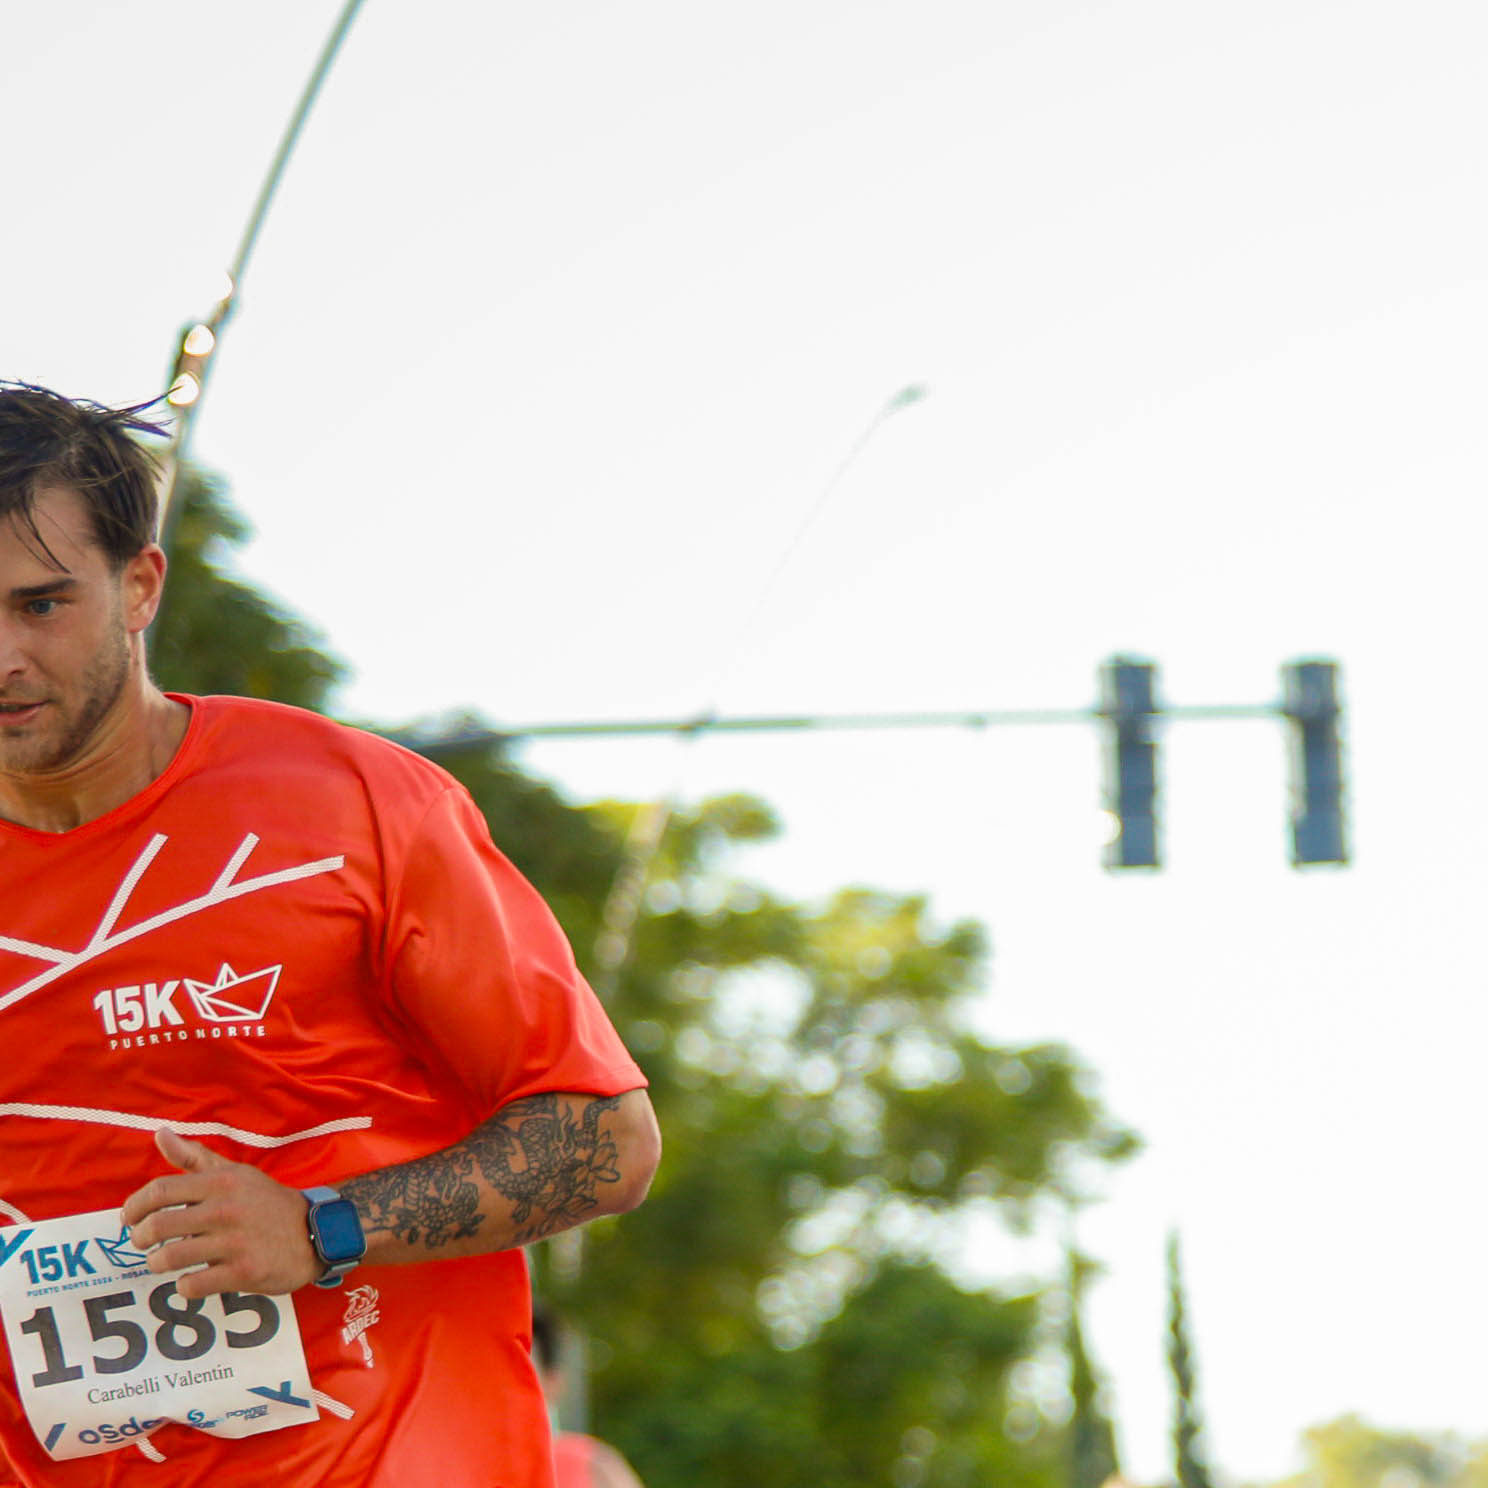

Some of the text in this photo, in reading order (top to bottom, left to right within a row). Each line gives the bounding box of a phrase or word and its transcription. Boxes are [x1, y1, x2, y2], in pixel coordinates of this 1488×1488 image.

[93, 980, 185, 1035] 15K
[110, 1025, 266, 1050] PUERTO NORTE
[20, 1239, 97, 1284] 15K
[20, 1281, 281, 1388] 1585
[87, 1364, 235, 1406] Carabelli Valentin
